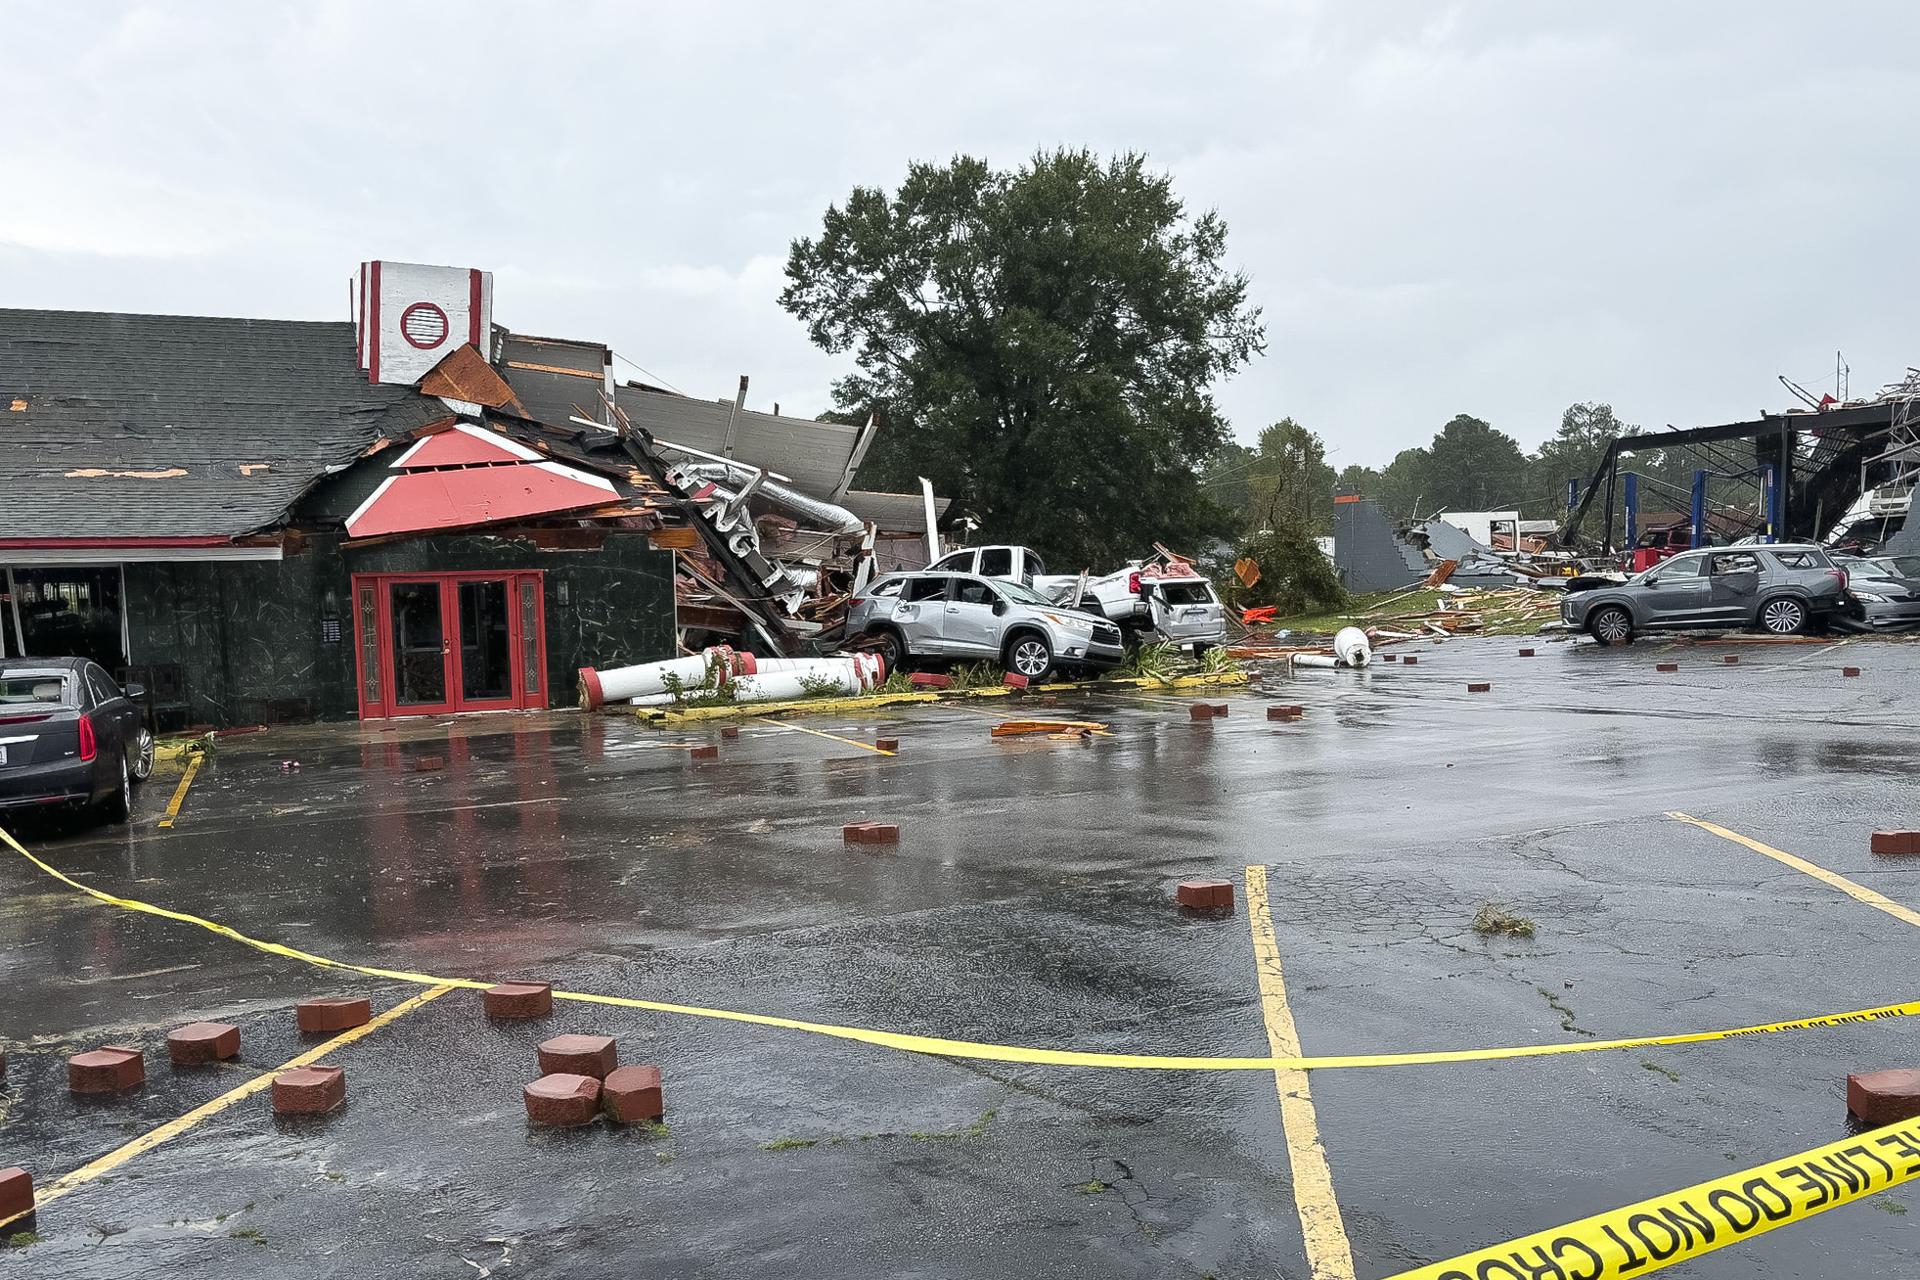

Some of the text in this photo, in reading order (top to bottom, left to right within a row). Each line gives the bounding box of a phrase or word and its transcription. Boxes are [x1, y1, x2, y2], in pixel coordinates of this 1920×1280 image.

[1708, 1177, 1793, 1234] DO
[1775, 1144, 1894, 1210] LINE
[1600, 1200, 1716, 1274] NOT
